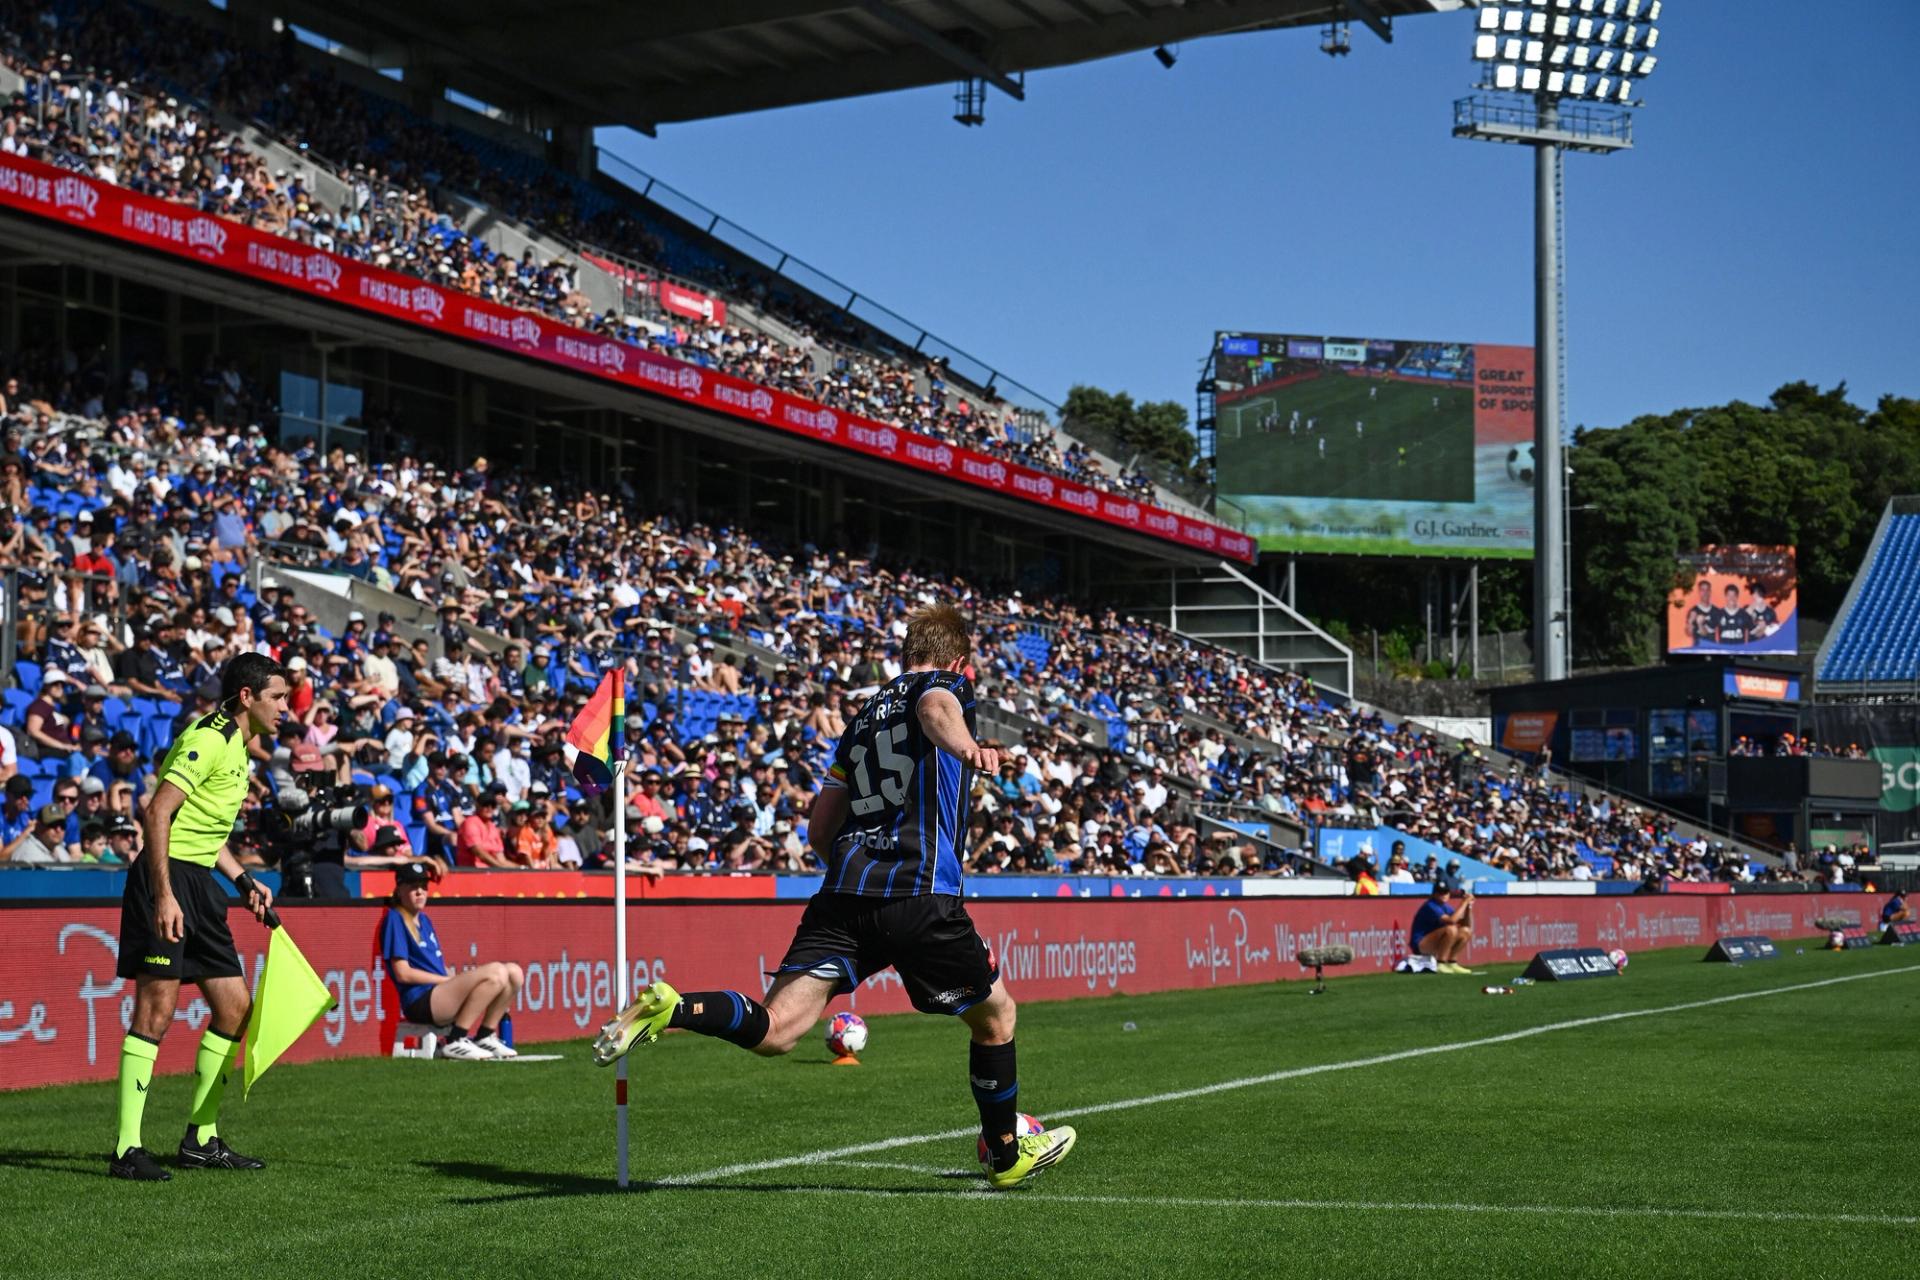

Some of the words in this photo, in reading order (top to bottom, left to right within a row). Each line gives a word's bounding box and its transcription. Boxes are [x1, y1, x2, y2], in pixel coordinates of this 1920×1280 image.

[20, 172, 35, 198] TO
[54, 176, 99, 218] HEINZ
[187, 217, 227, 255] HEINZ
[306, 254, 341, 289] HEINZ
[1478, 369, 1524, 381] GREAT
[1479, 398, 1496, 409] OF
[849, 722, 915, 816] 15
[323, 955, 386, 1047] get
[514, 949, 667, 1028] ortgaes
[999, 928, 1039, 981] Kiwi
[1045, 935, 1136, 989] mortgages
[1274, 923, 1297, 963] We
